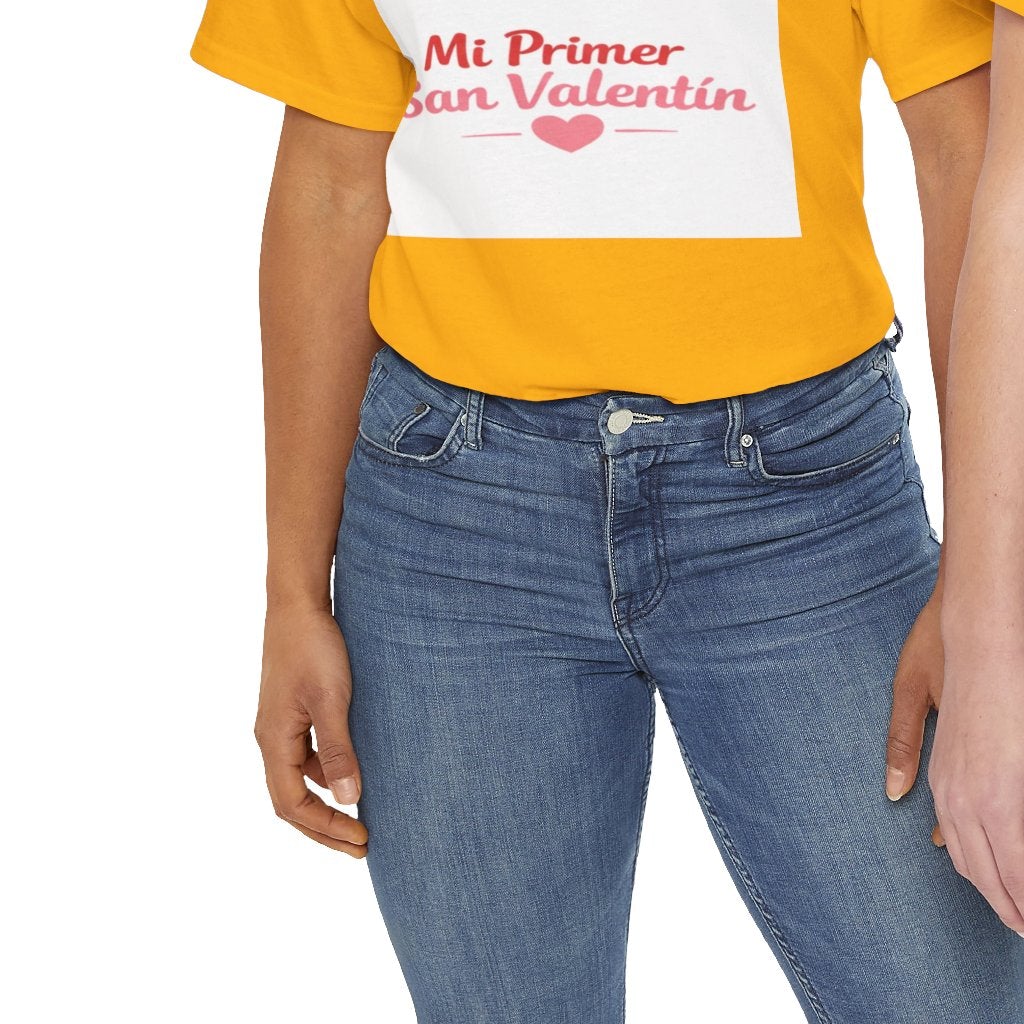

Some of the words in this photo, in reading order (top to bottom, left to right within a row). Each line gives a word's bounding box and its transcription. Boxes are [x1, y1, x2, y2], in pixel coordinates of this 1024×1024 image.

[424, 31, 493, 72] Mi
[503, 28, 685, 68] Primer
[506, 68, 756, 112] Valentín
